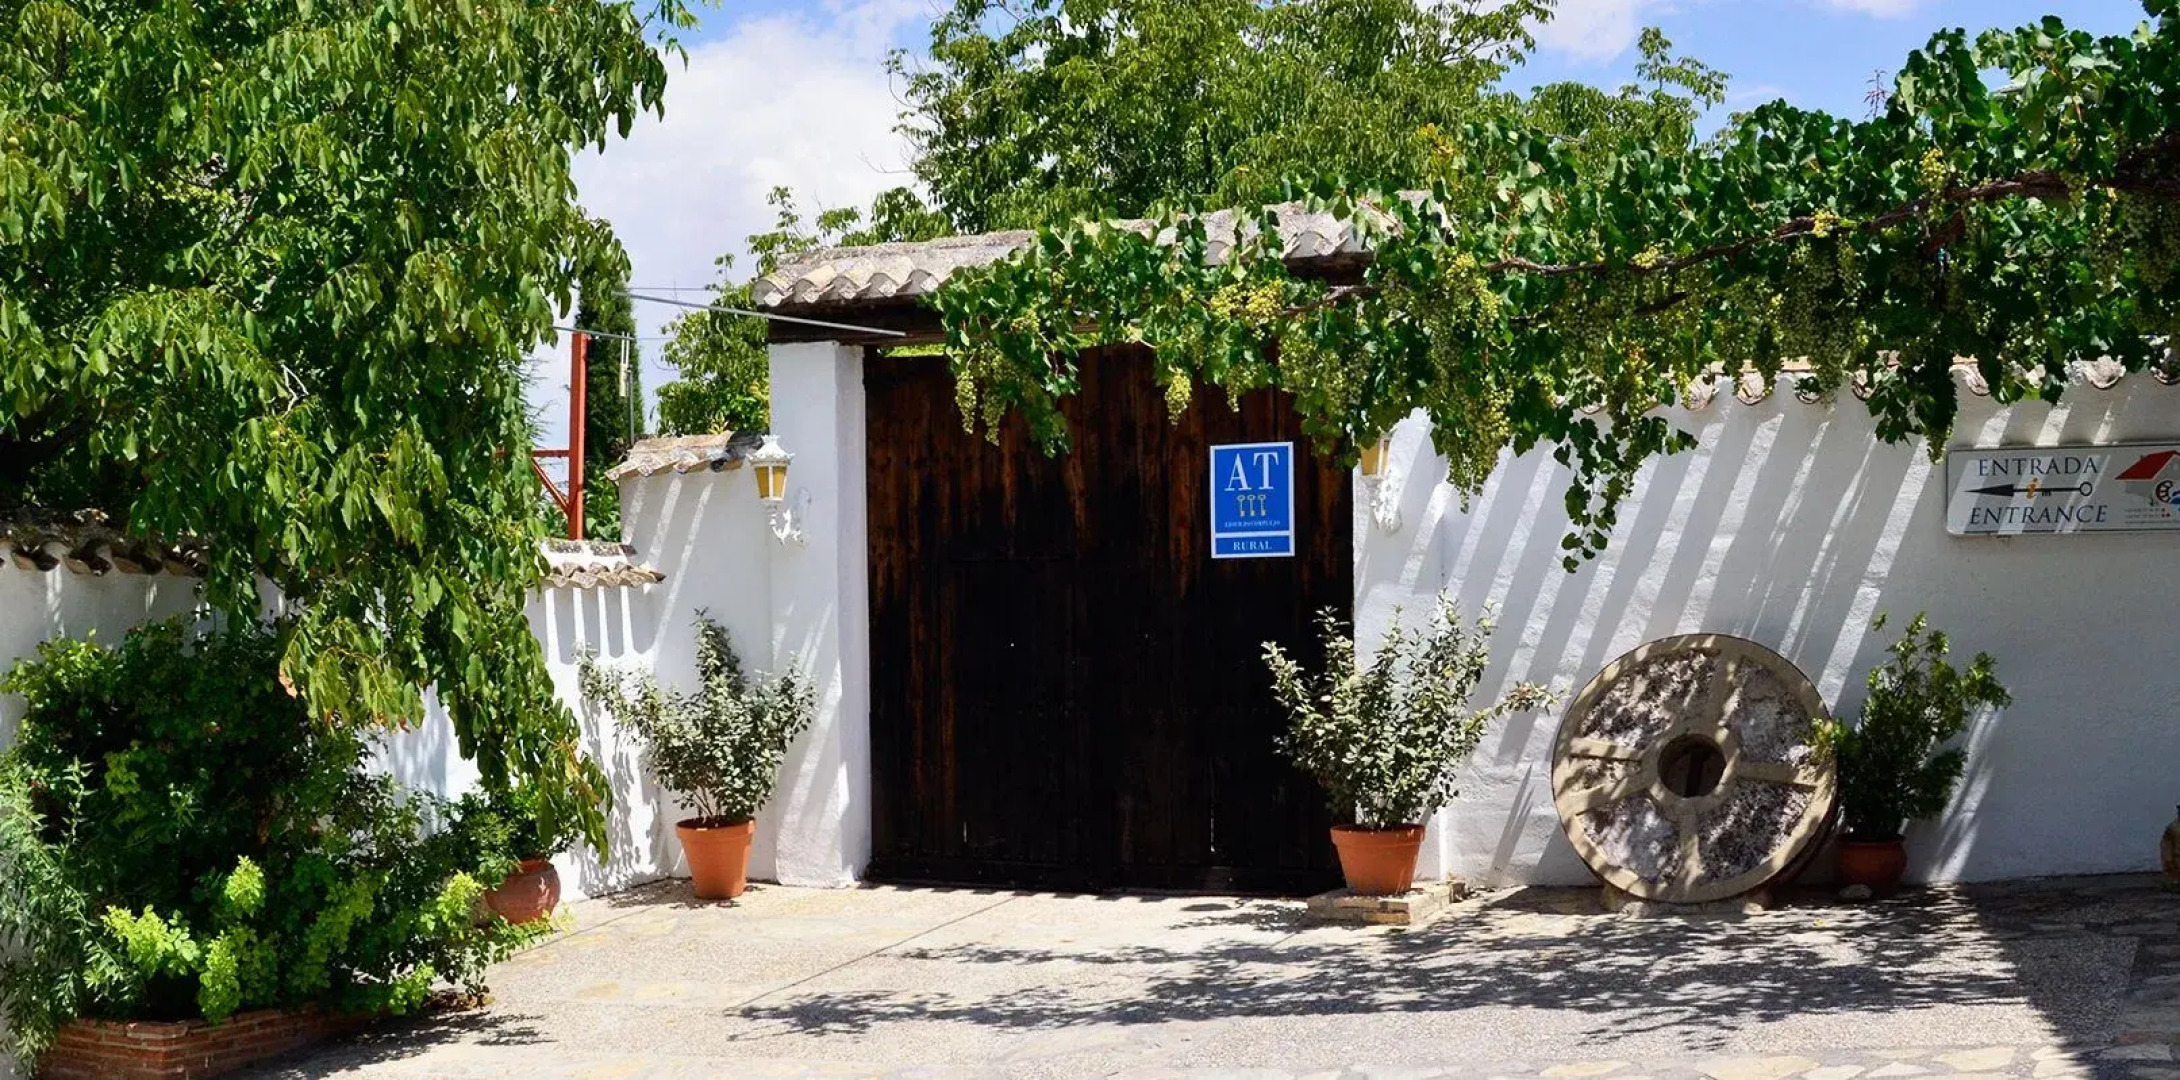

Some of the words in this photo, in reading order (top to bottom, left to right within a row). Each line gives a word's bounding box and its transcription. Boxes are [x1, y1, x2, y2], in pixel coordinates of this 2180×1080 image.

[1224, 453, 1279, 491] AT
[1979, 457, 2098, 477] ENTRADA
[1970, 505, 2107, 524] ENTRANCE
[1233, 541, 1272, 550] RURAL
